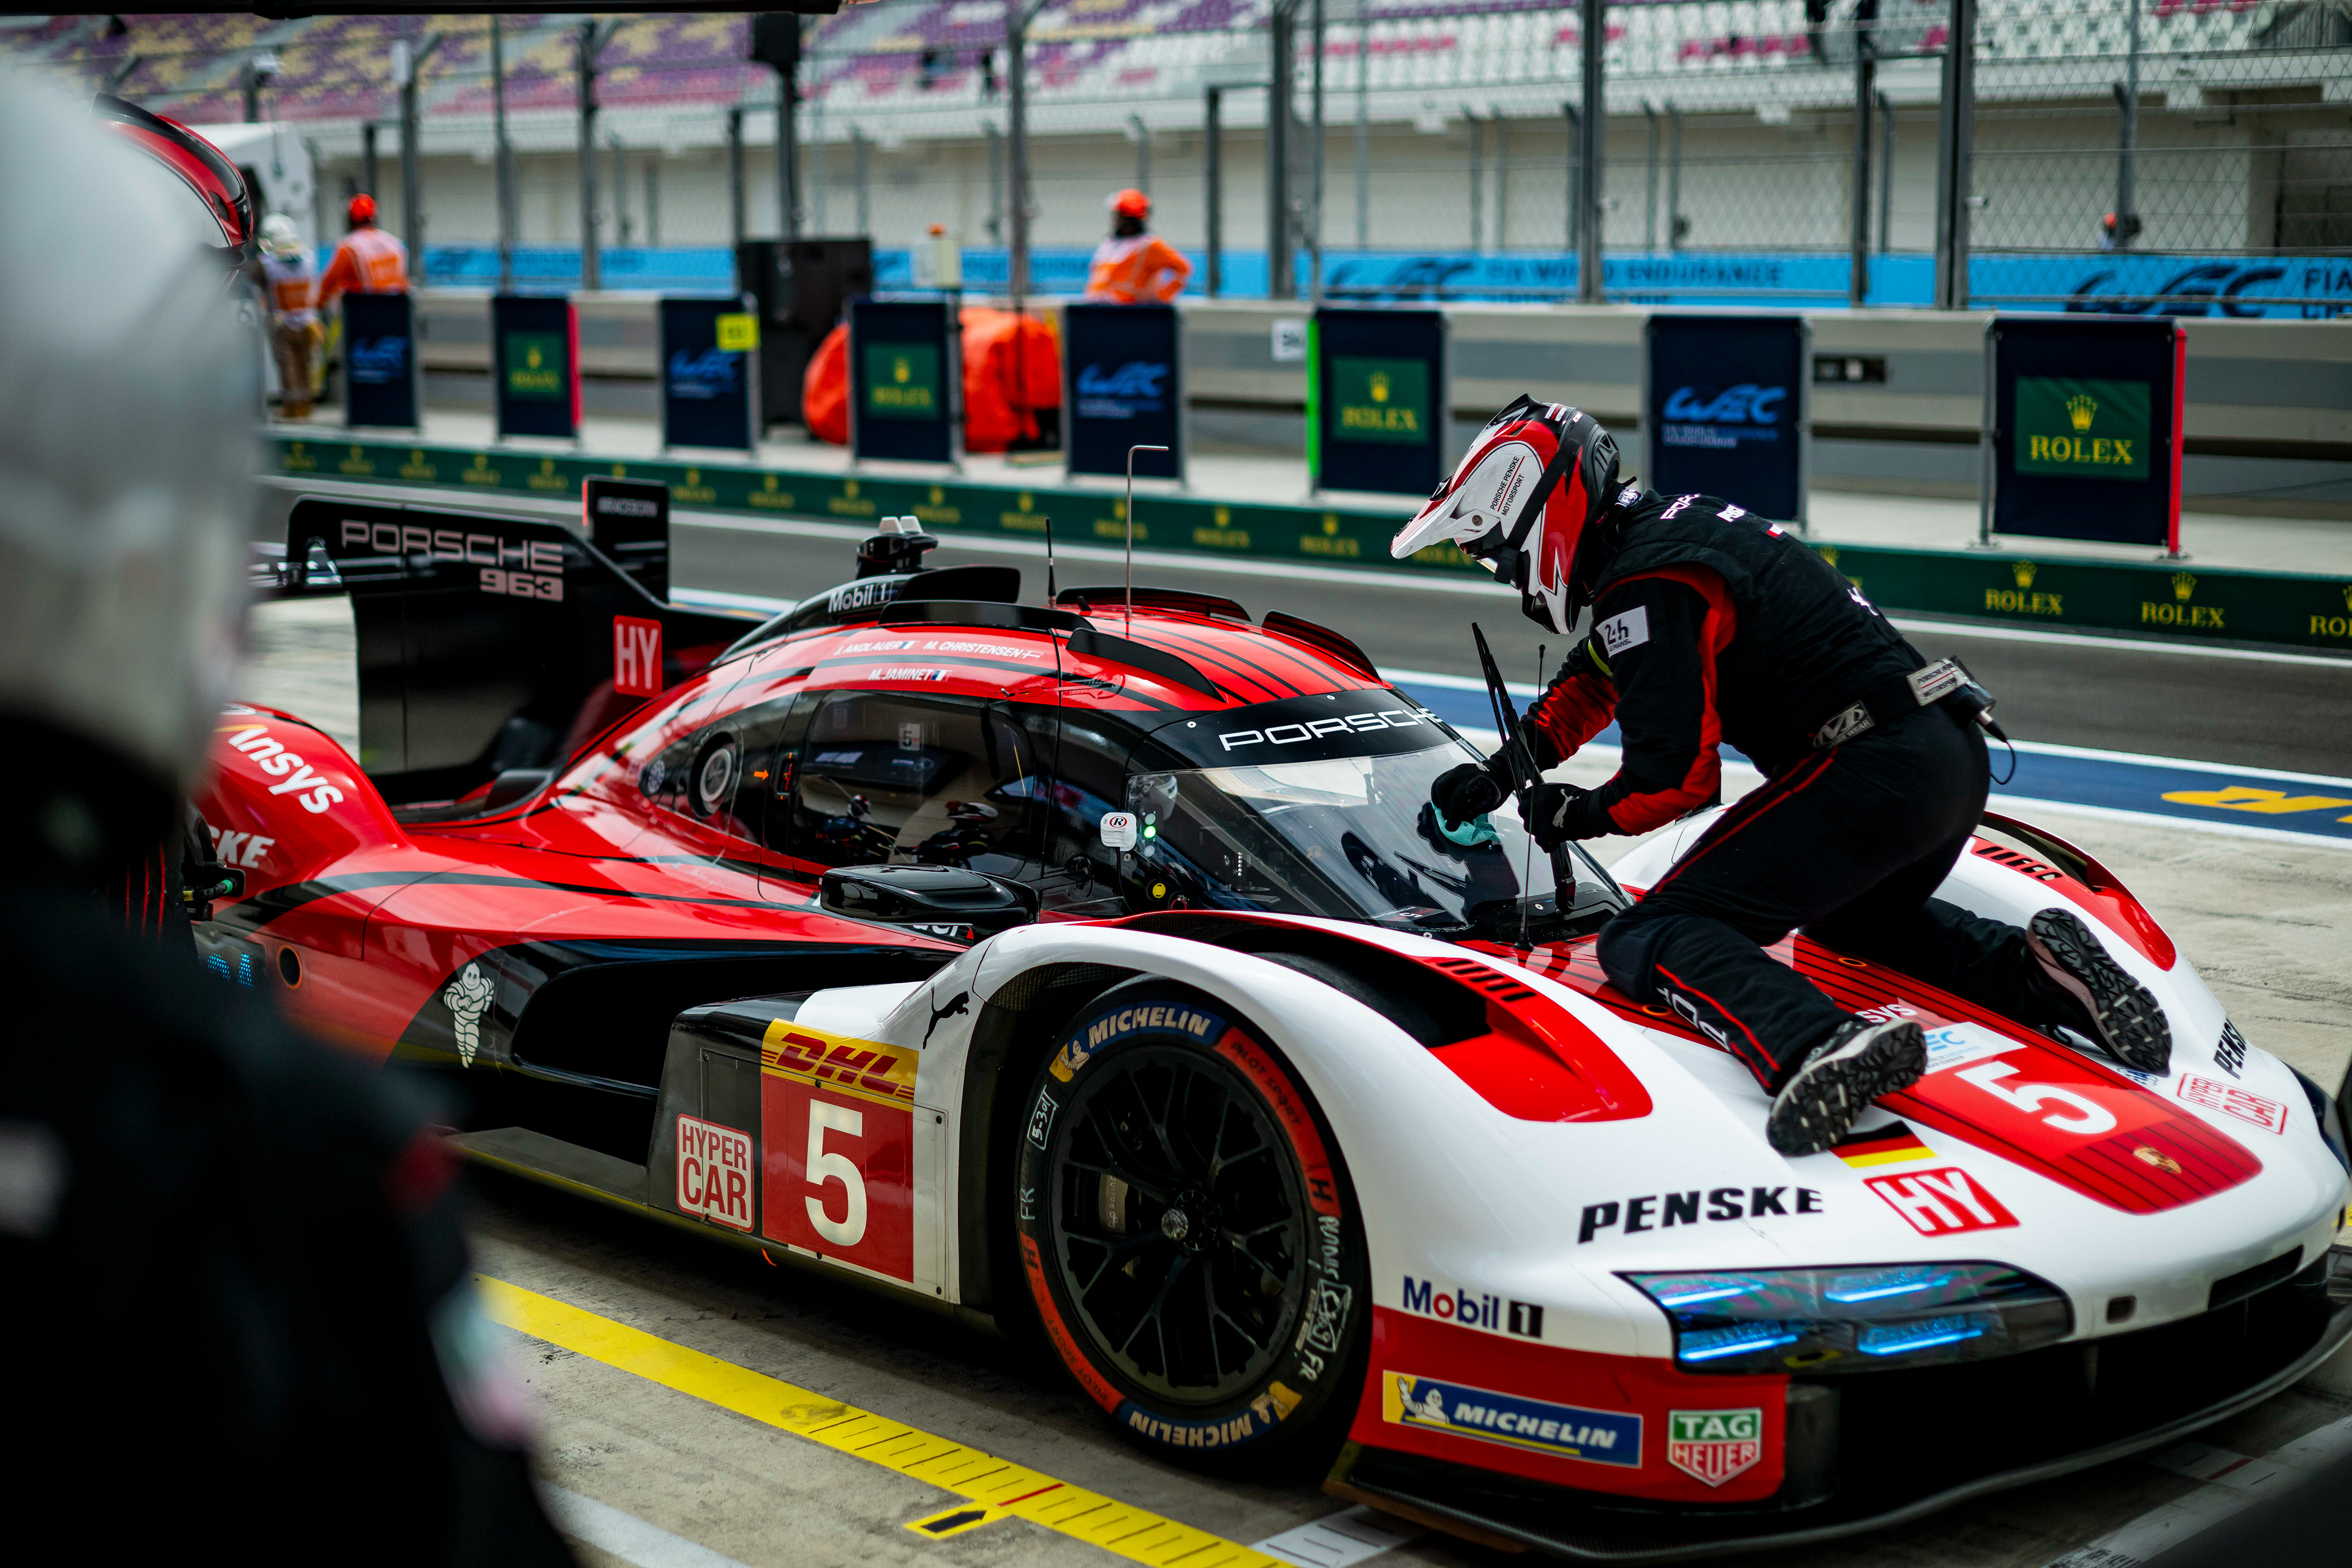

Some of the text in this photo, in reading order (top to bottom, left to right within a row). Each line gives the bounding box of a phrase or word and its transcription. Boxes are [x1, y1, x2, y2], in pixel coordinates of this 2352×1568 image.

[2030, 434, 2133, 466] ROLEX
[1490, 456, 1520, 510] PORSCHE PENSKE
[1501, 473, 1525, 516] MOTORSPORT
[341, 520, 563, 574] PORSCHE
[480, 568, 563, 601] 963
[827, 584, 874, 613] Mobil
[1985, 587, 2063, 616] ROLEX
[2141, 601, 2226, 629] ROLEX
[616, 624, 659, 690] HY
[938, 641, 1025, 658] CHRISTENSEN
[881, 668, 936, 681] JAMINET
[1219, 707, 1444, 752] PORSCHE
[1088, 1006, 1212, 1049] MICHELIN
[776, 1032, 899, 1095] DHL
[1231, 1042, 1301, 1125] PILOT SPORT
[1954, 1061, 2117, 1135] 5
[2187, 1077, 2225, 1109] HYPER
[2223, 1089, 2277, 1127] CAR
[682, 1123, 747, 1172] HYPER
[682, 1157, 748, 1221] CAR
[805, 1098, 868, 1246] 5
[1308, 1177, 1333, 1202] H
[1577, 1185, 1825, 1245] PENSKE
[1871, 1171, 1998, 1232] HY
[1022, 1245, 1039, 1270] H
[1403, 1276, 1499, 1332] Mobil
[1128, 1410, 1254, 1447] MICHELIN
[1454, 1402, 1617, 1449] MICHELIN
[1677, 1412, 1753, 1439] TAG
[1672, 1443, 1756, 1477] HEUER
